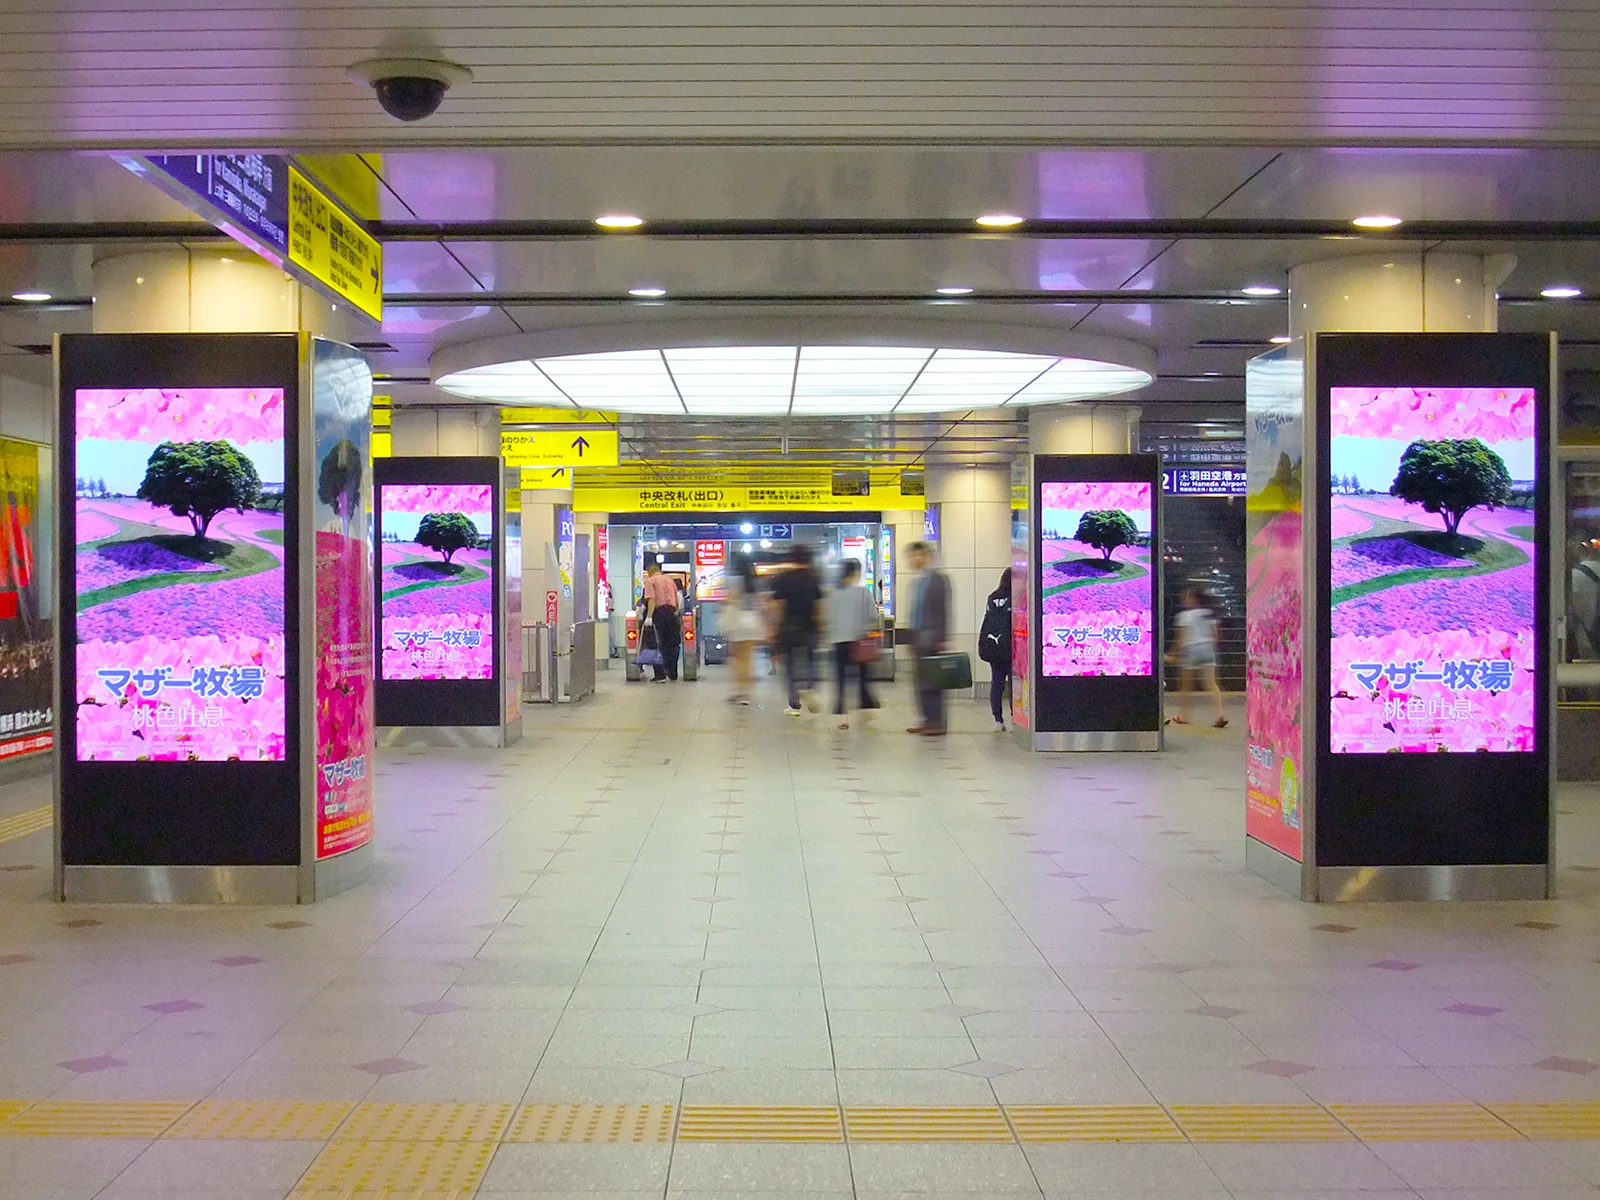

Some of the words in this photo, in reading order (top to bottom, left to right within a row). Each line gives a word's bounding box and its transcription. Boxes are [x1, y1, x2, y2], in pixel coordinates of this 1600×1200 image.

[393, 630, 481, 646] マザー牧場
[1053, 627, 1140, 643] マザー牧場
[97, 666, 265, 698] マザー牧場
[1350, 660, 1513, 691] マザー牧場
[131, 705, 224, 728] 桃色吐息
[1383, 698, 1473, 721] 桃色吐息
